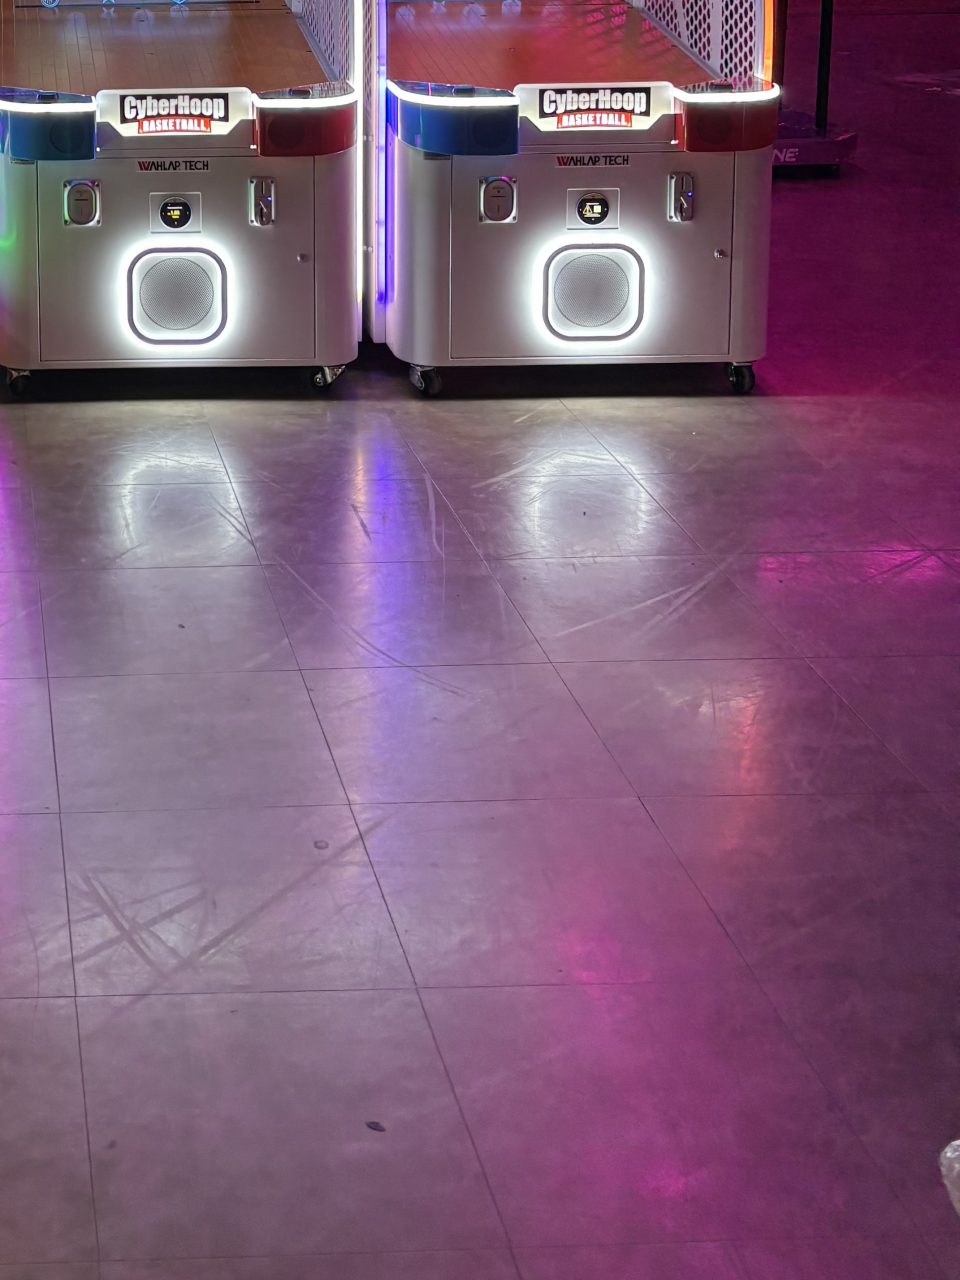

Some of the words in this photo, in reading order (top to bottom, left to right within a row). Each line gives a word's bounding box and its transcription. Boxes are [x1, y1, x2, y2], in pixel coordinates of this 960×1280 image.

[123, 95, 225, 120] CyberHoop
[543, 89, 647, 114] CyberHoop
[142, 119, 208, 132] BASKETBALL
[561, 113, 629, 127] BASKETBALL
[137, 160, 180, 171] WAHLAP
[182, 160, 209, 171] TECH
[556, 155, 599, 167] WAHLAP
[600, 155, 629, 166] TECH
